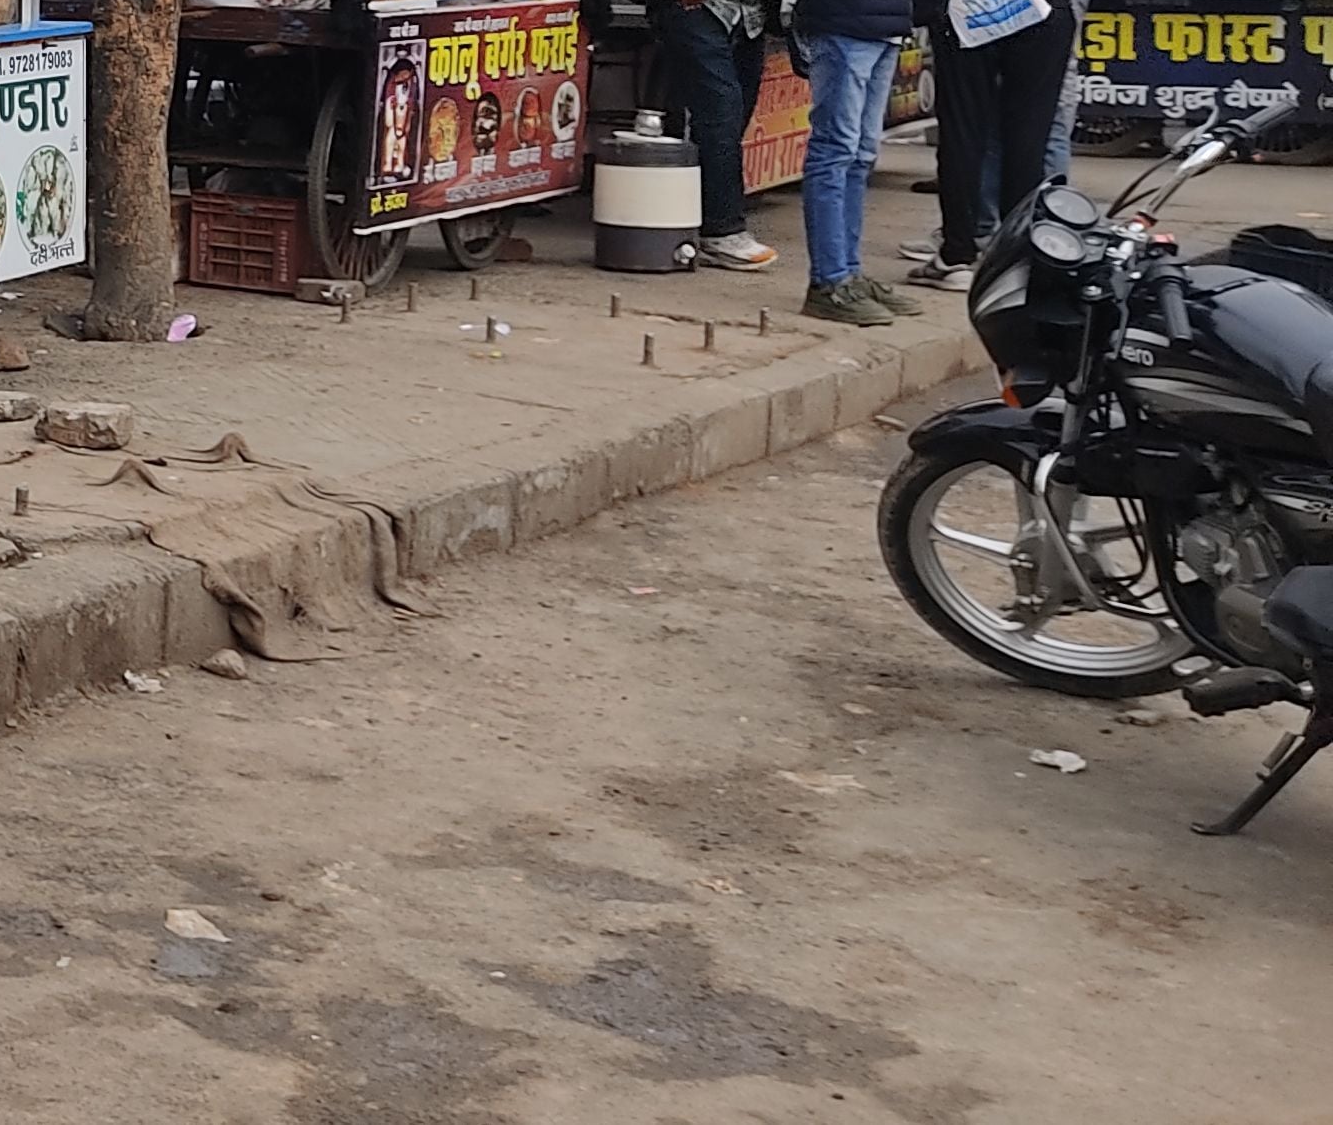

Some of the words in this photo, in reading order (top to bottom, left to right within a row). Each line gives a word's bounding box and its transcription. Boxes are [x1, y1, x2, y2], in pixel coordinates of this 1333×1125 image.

[429, 35, 482, 100] कालू
[485, 17, 527, 79] बर्गर
[530, 11, 580, 76] फराई
[1152, 12, 1286, 64] फास्ट
[9, 50, 73, 75] 9728179083
[1121, 345, 1154, 367] ero
